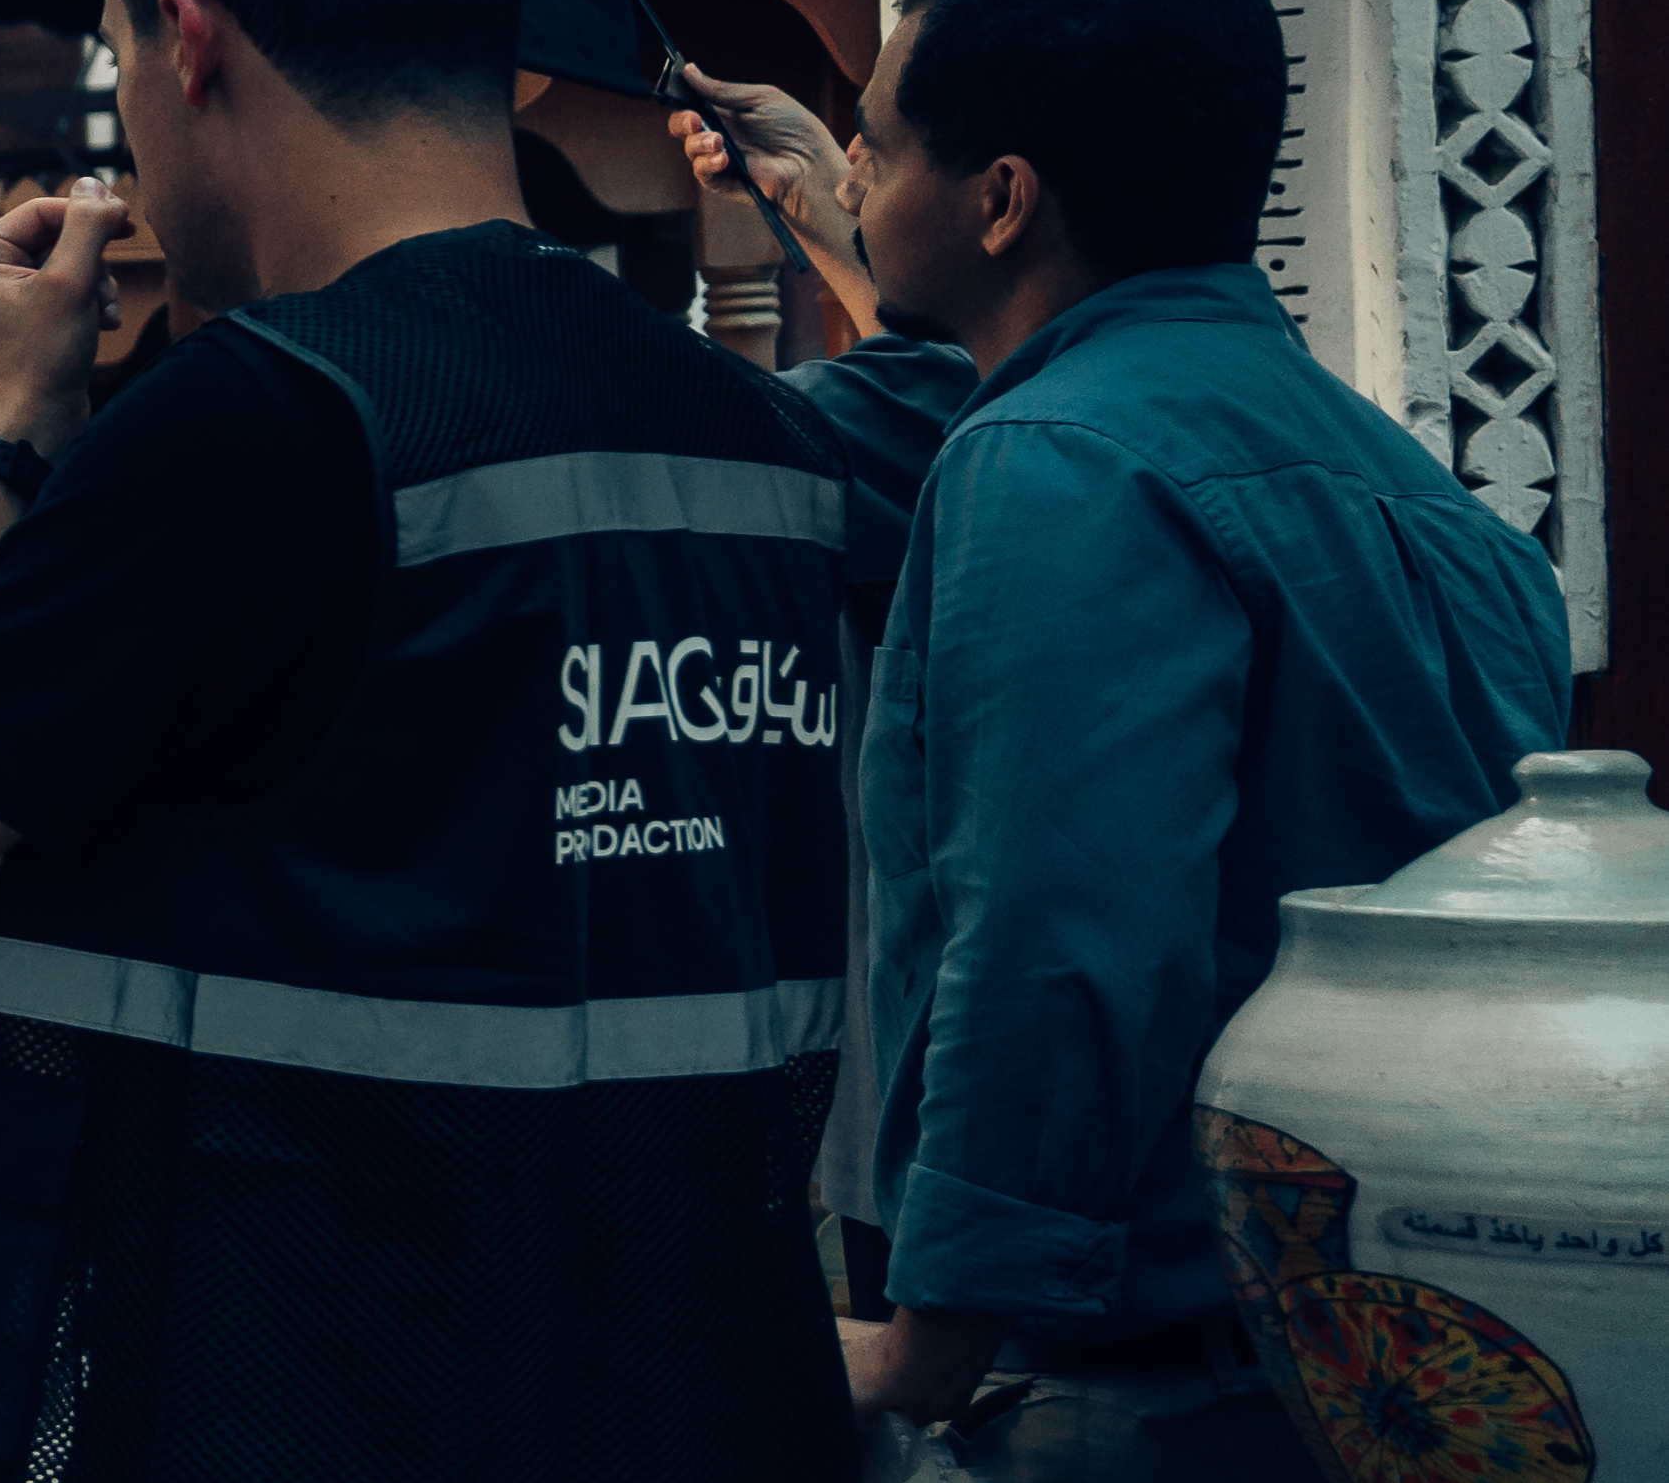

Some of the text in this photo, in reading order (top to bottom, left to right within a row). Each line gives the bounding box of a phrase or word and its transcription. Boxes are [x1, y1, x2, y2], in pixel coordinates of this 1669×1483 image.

[555, 778, 644, 820] MEDIA
[1554, 1227, 1619, 1258] واحد
[1627, 1228, 1664, 1258] كل
